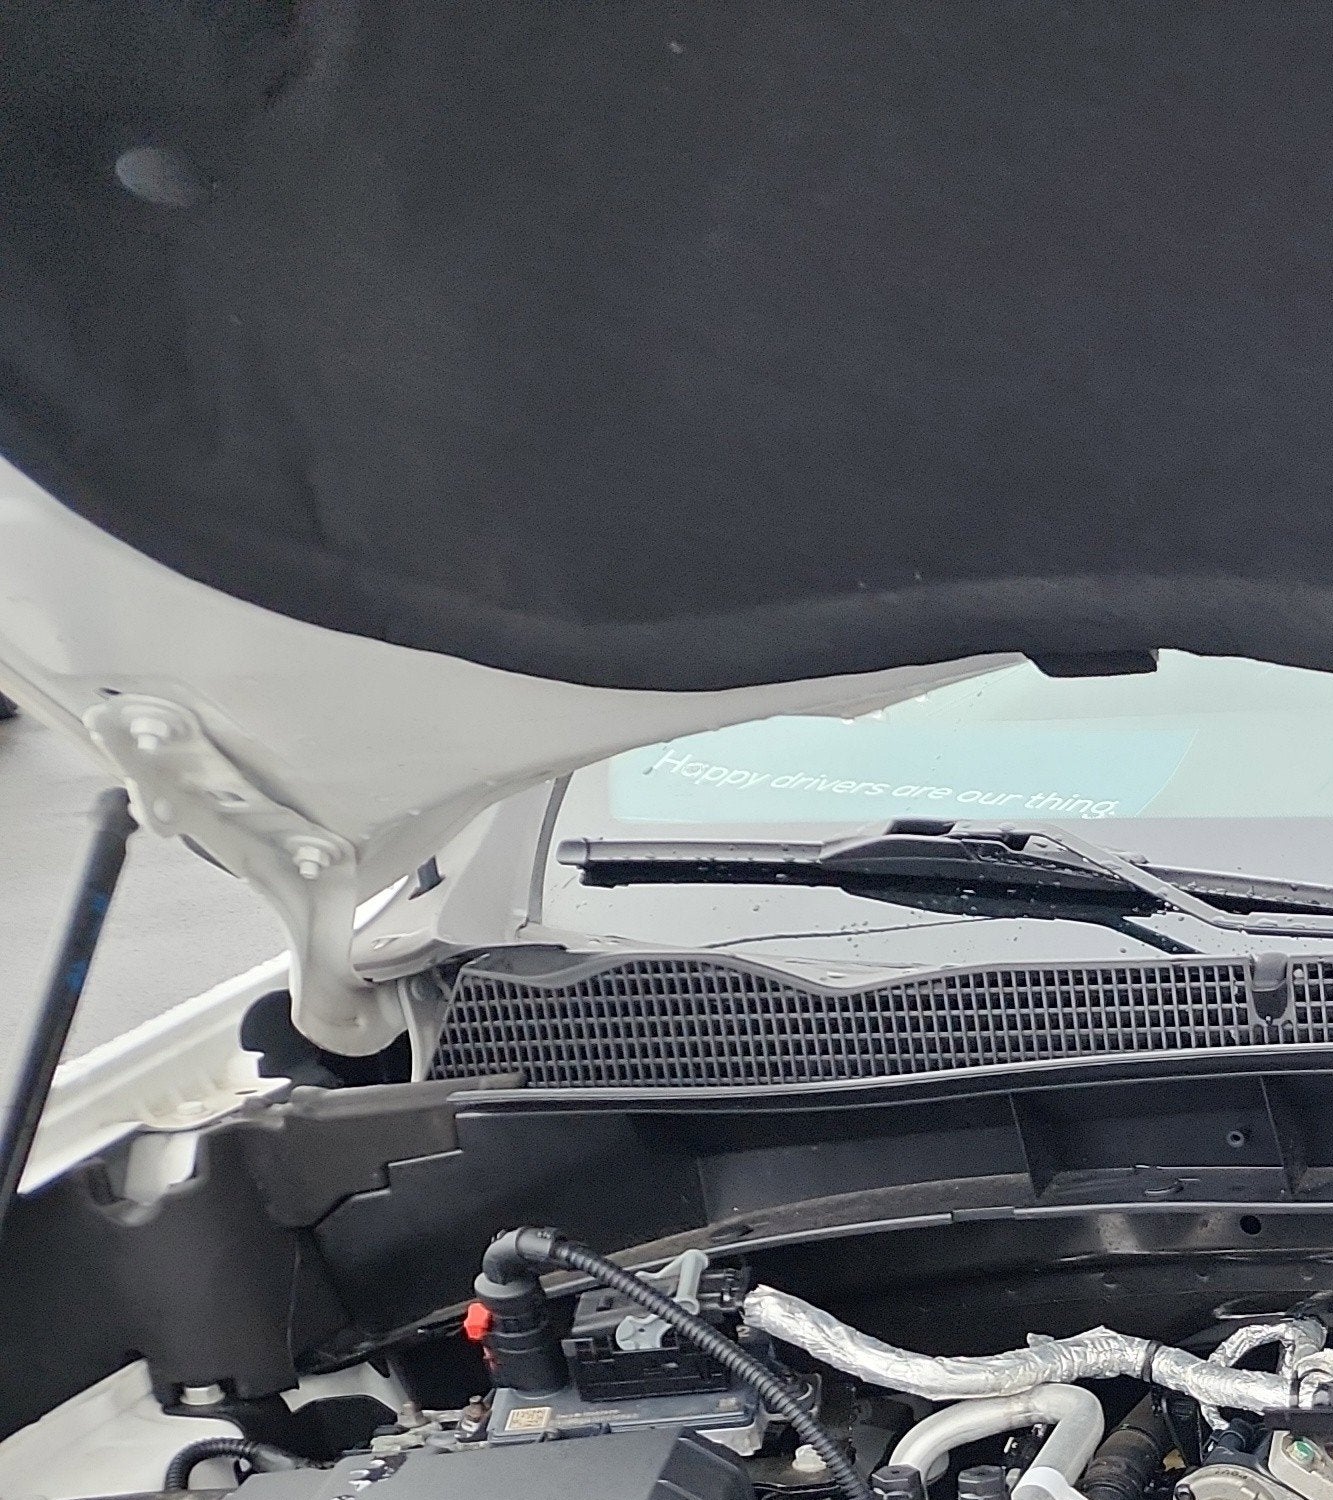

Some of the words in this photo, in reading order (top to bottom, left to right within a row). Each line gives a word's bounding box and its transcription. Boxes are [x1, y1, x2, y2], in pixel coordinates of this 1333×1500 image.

[653, 749, 770, 789] Happy
[770, 772, 890, 796] drivers
[892, 784, 952, 799] are
[957, 790, 1023, 806] our
